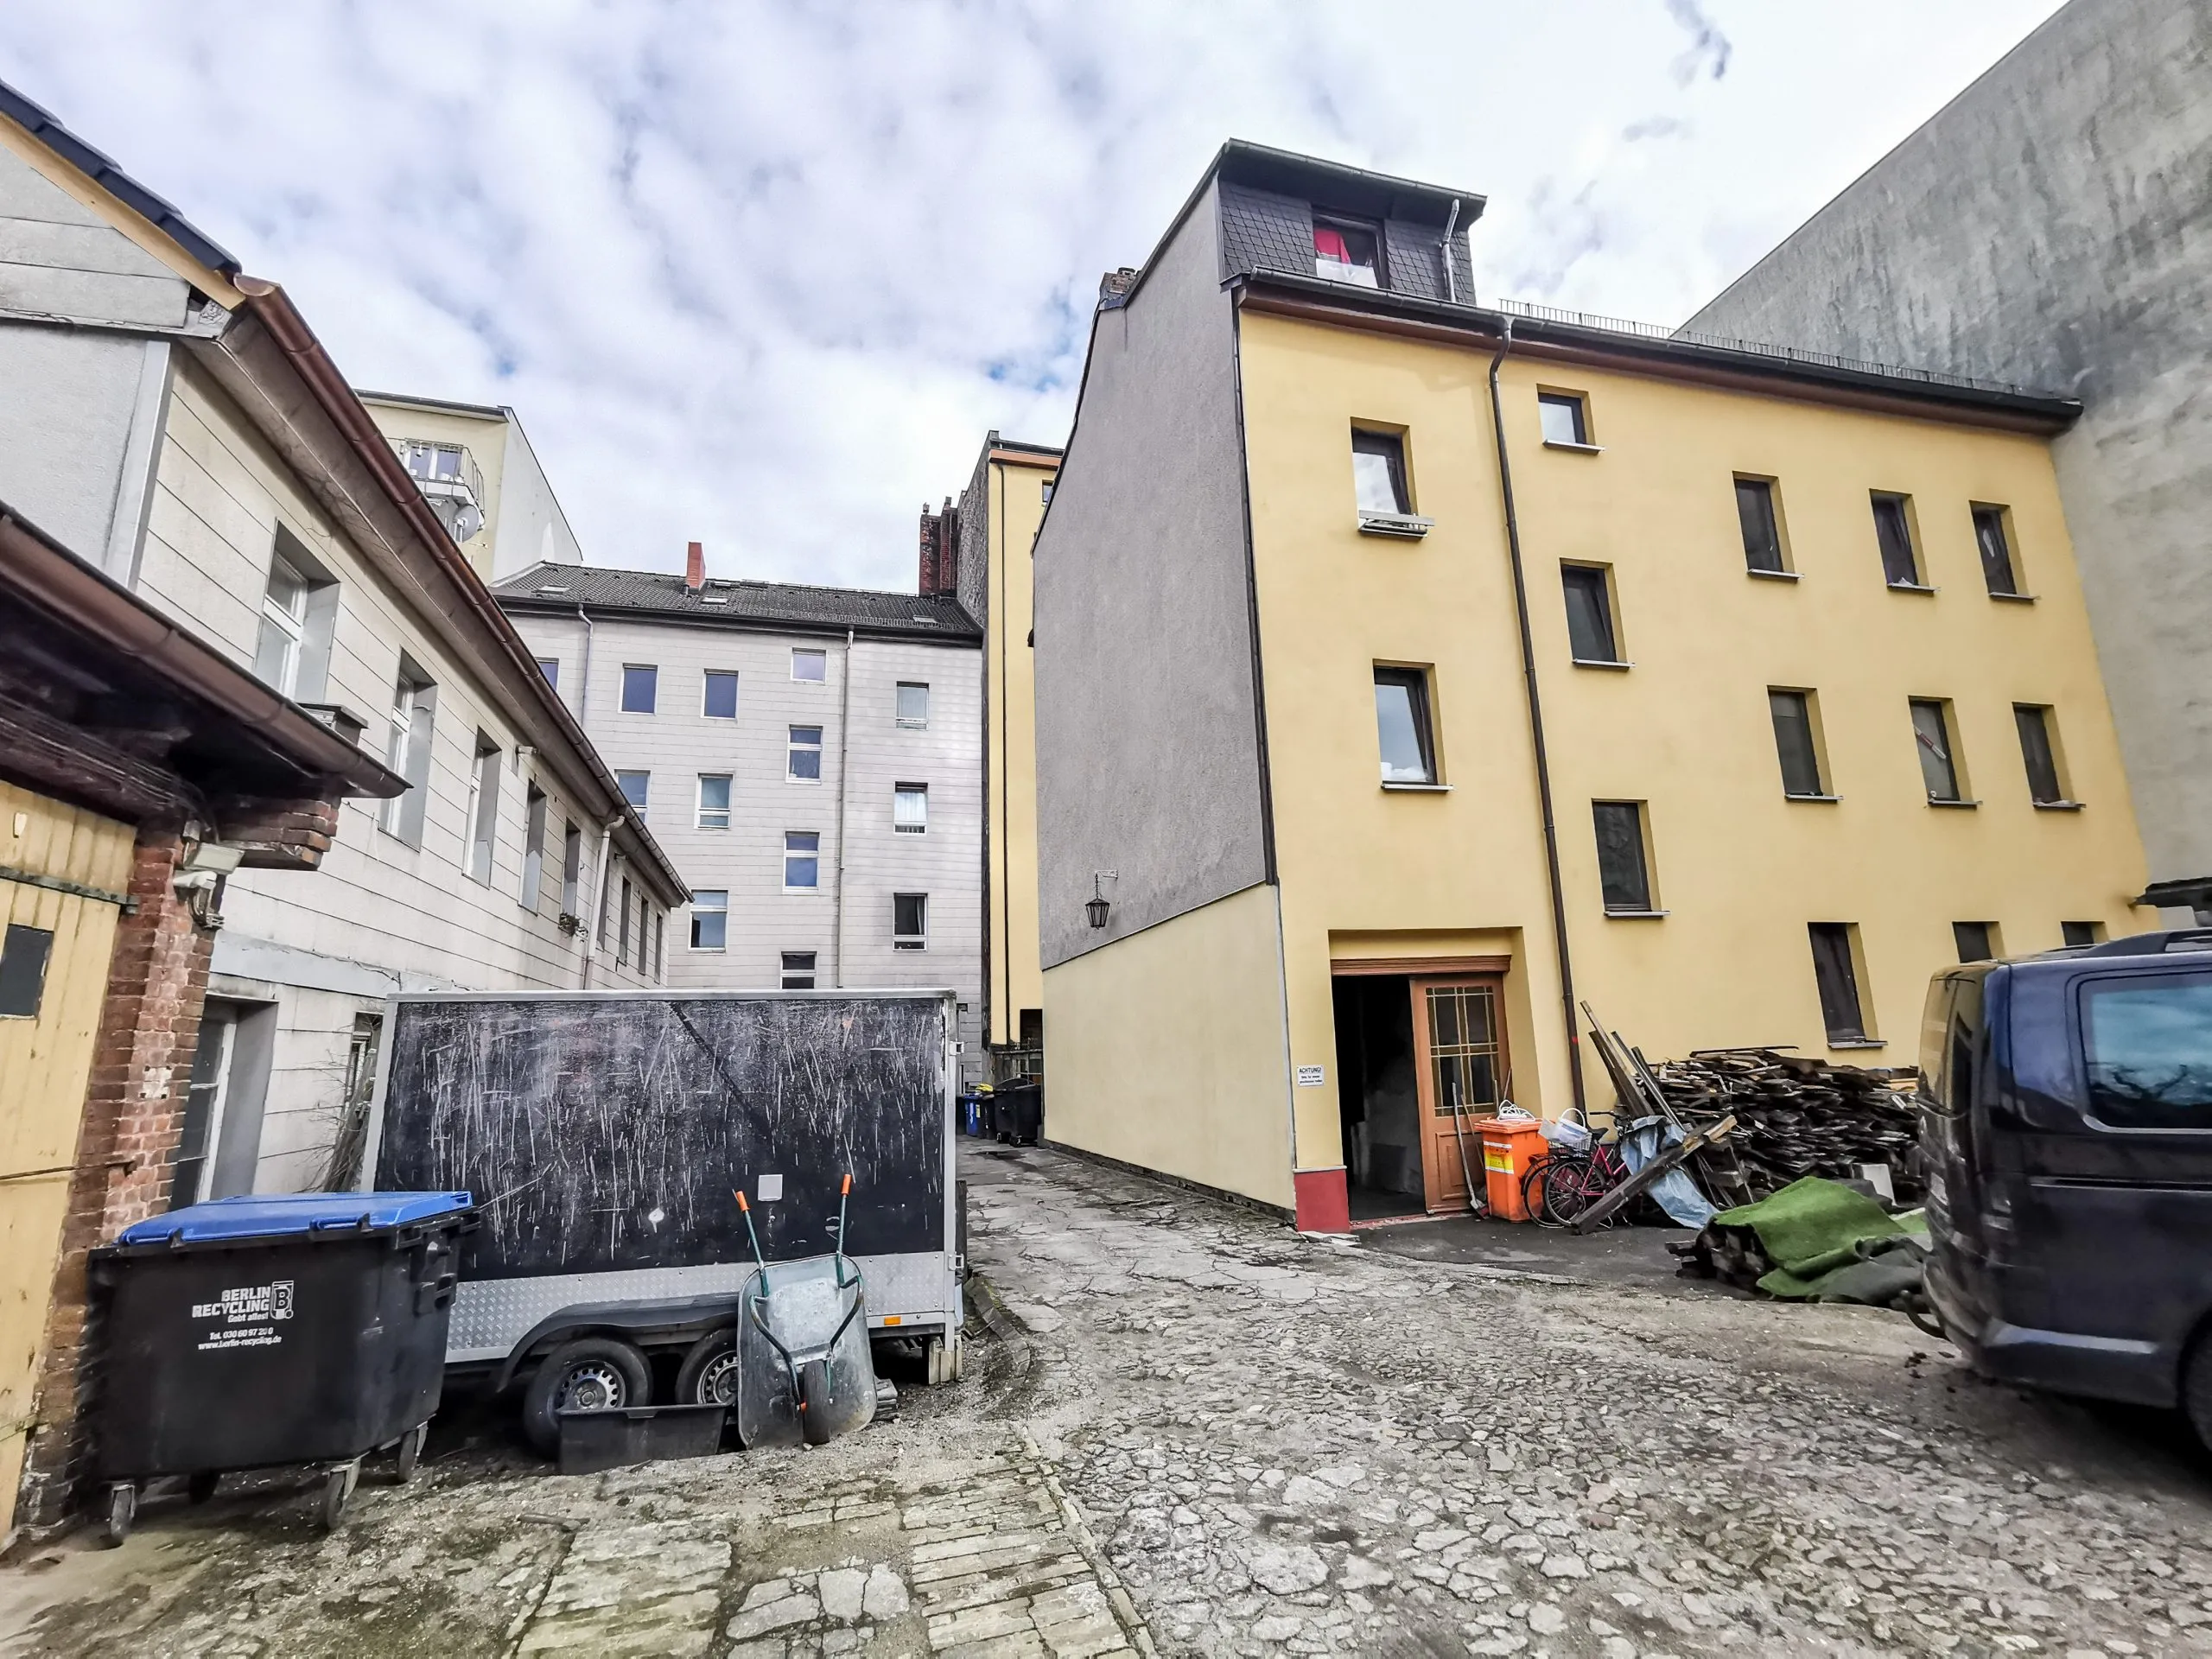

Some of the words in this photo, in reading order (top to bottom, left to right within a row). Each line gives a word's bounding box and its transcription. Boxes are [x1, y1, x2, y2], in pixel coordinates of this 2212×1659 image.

[222, 1287, 270, 1301] BERLIN
[192, 1299, 270, 1318] RECYCLING
[223, 1330, 237, 1338] 030
